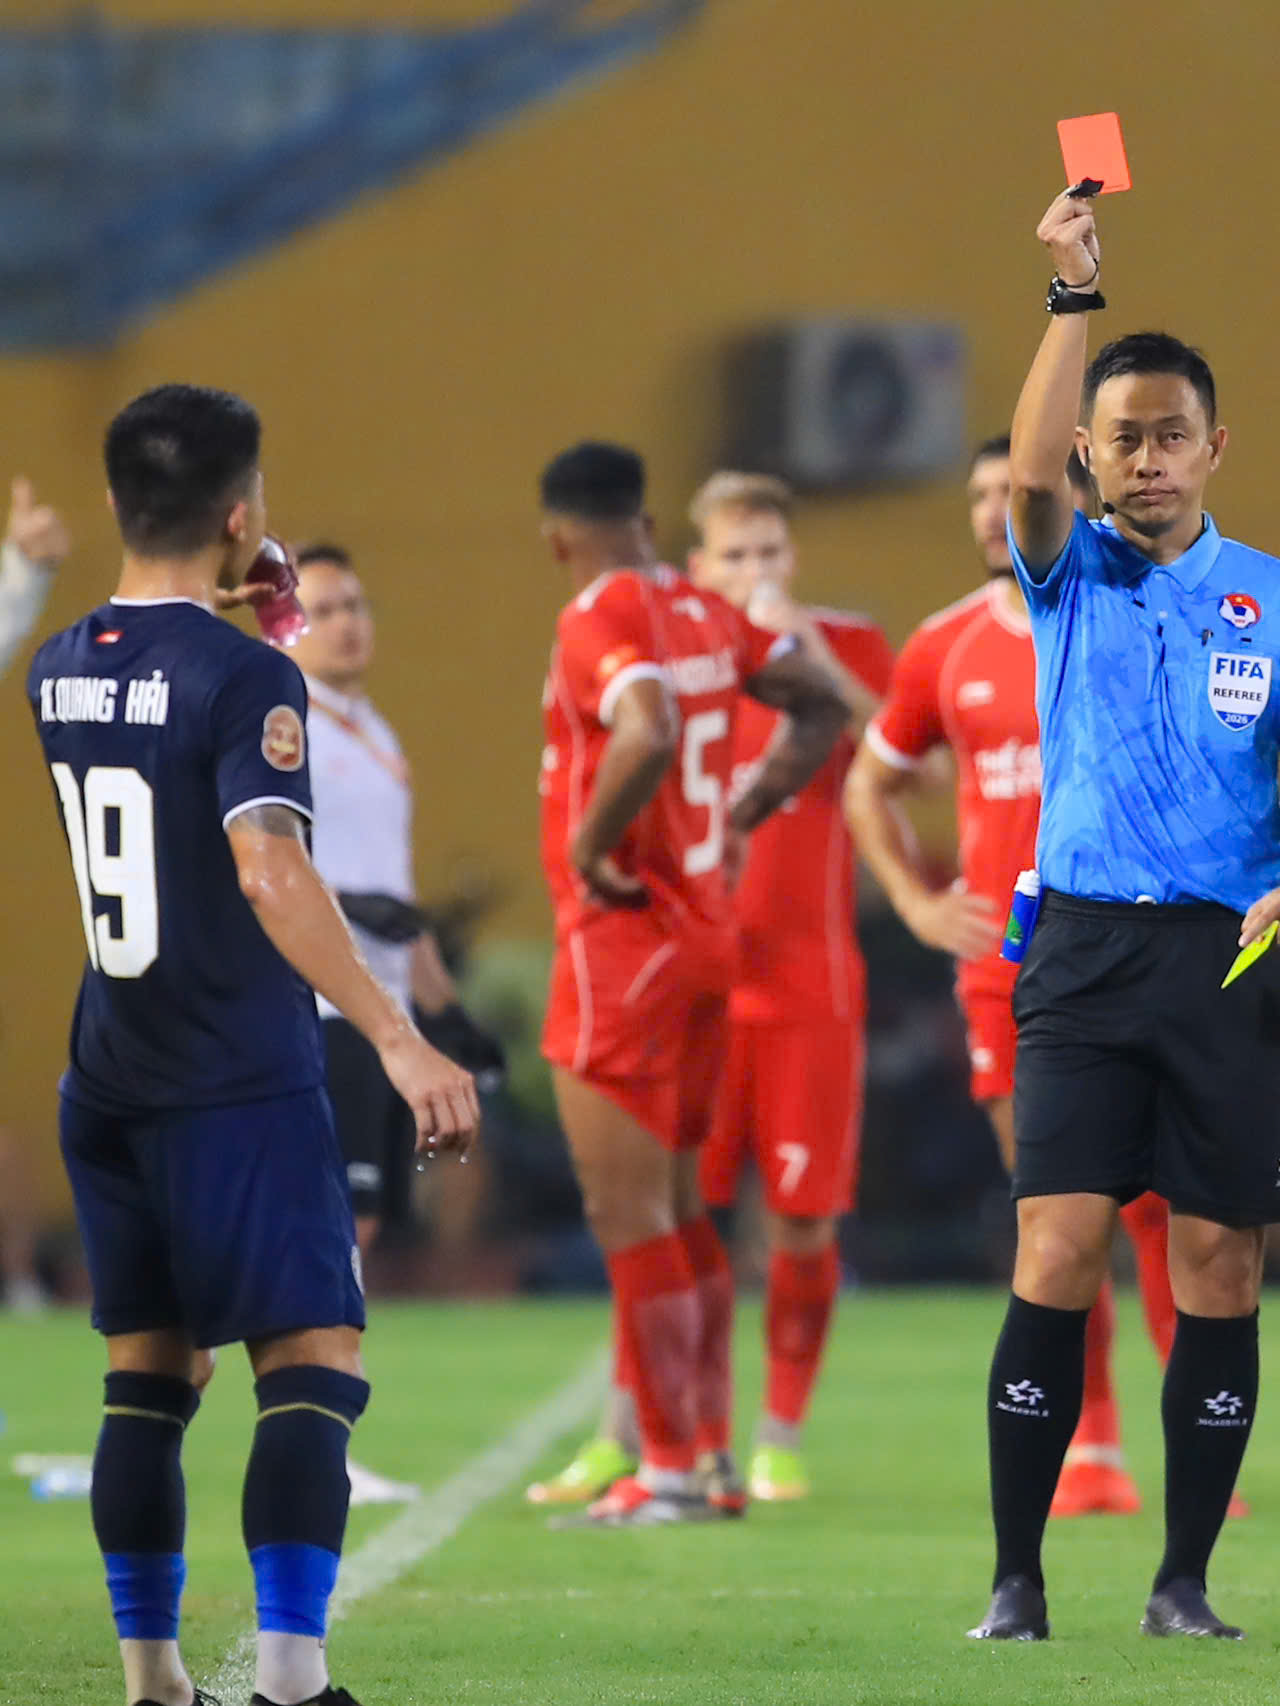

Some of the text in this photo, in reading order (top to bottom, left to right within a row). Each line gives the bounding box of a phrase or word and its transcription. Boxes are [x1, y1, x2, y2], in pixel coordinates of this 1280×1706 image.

[1213, 687, 1263, 702] REFEREE
[1215, 657, 1264, 680] FIFA
[124, 669, 170, 726] HẢI
[682, 709, 729, 875] 5
[51, 762, 159, 979] 19
[776, 1142, 809, 1193] 7
